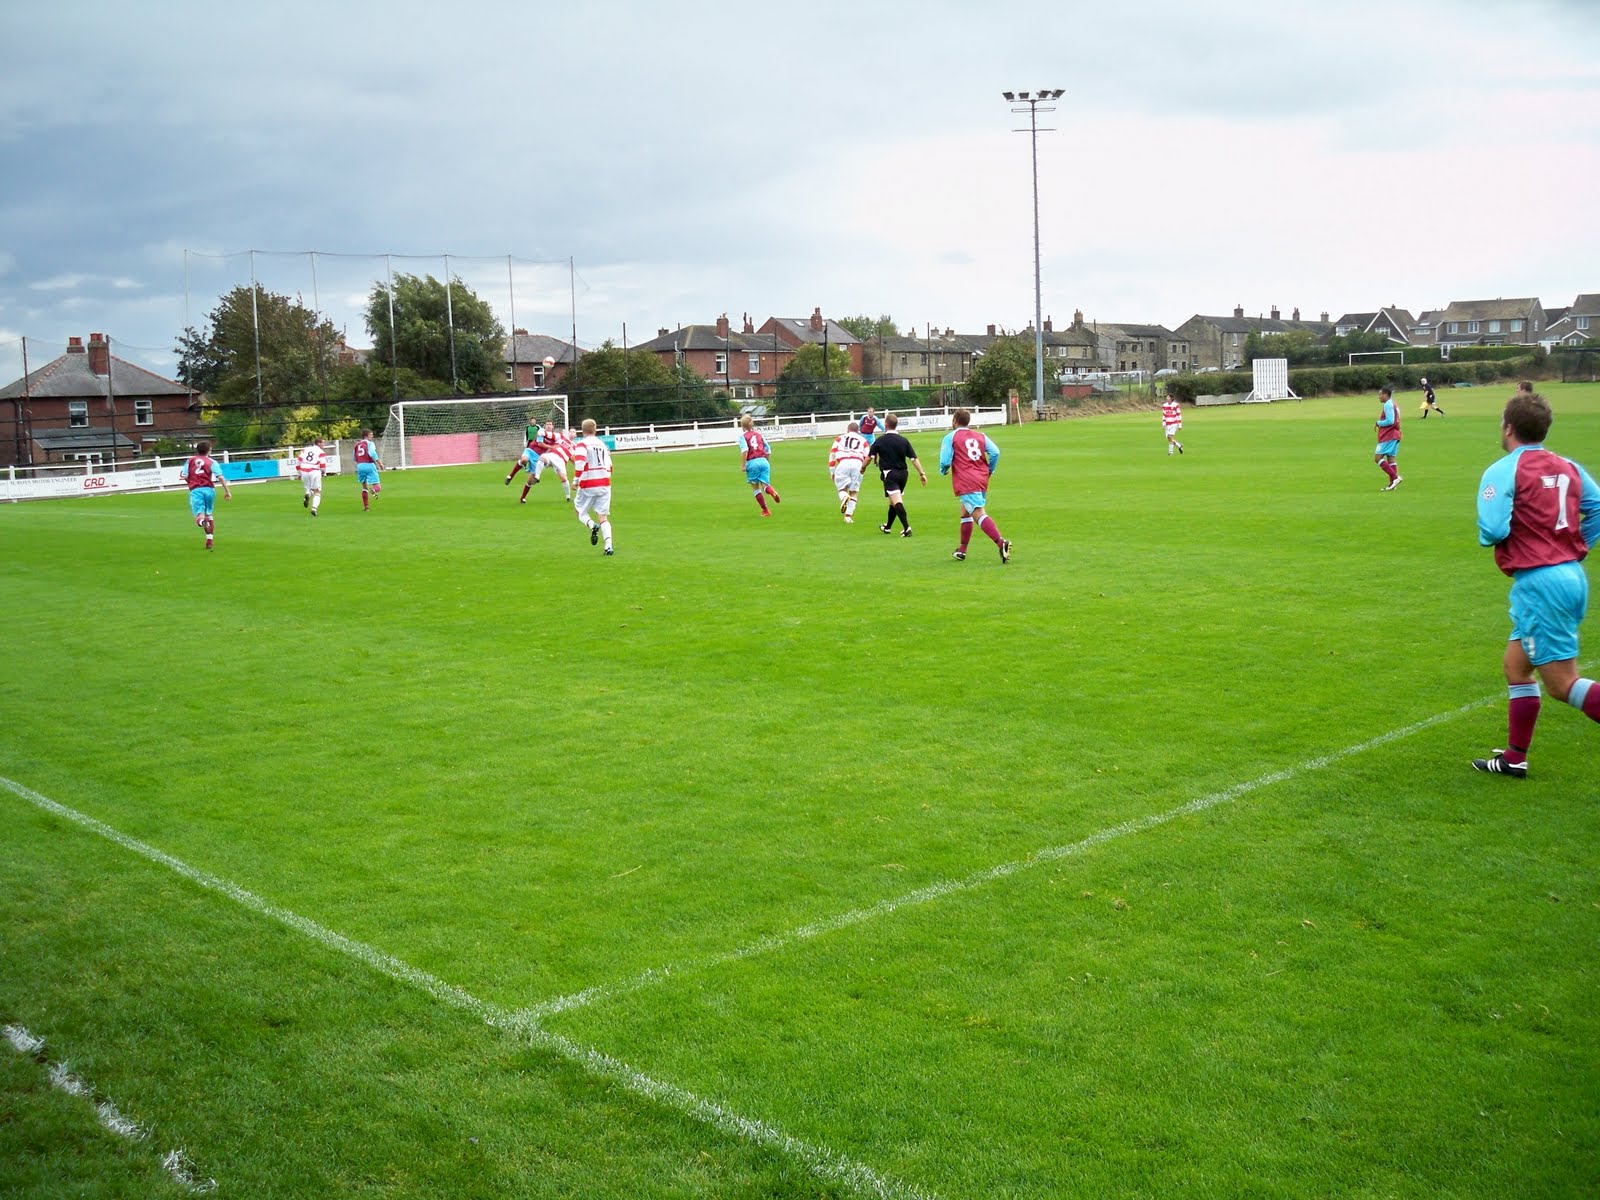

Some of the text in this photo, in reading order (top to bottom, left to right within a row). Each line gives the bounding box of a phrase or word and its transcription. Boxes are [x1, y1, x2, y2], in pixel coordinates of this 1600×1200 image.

[623, 435, 646, 443] Yorkshire
[647, 434, 659, 442] Bank
[750, 435, 759, 450] 4
[844, 436, 861, 450] 10
[306, 451, 315, 462] 8
[357, 443, 366, 457] 5
[964, 437, 982, 462] 8
[195, 459, 206, 475] 2
[84, 477, 106, 488] CRD
